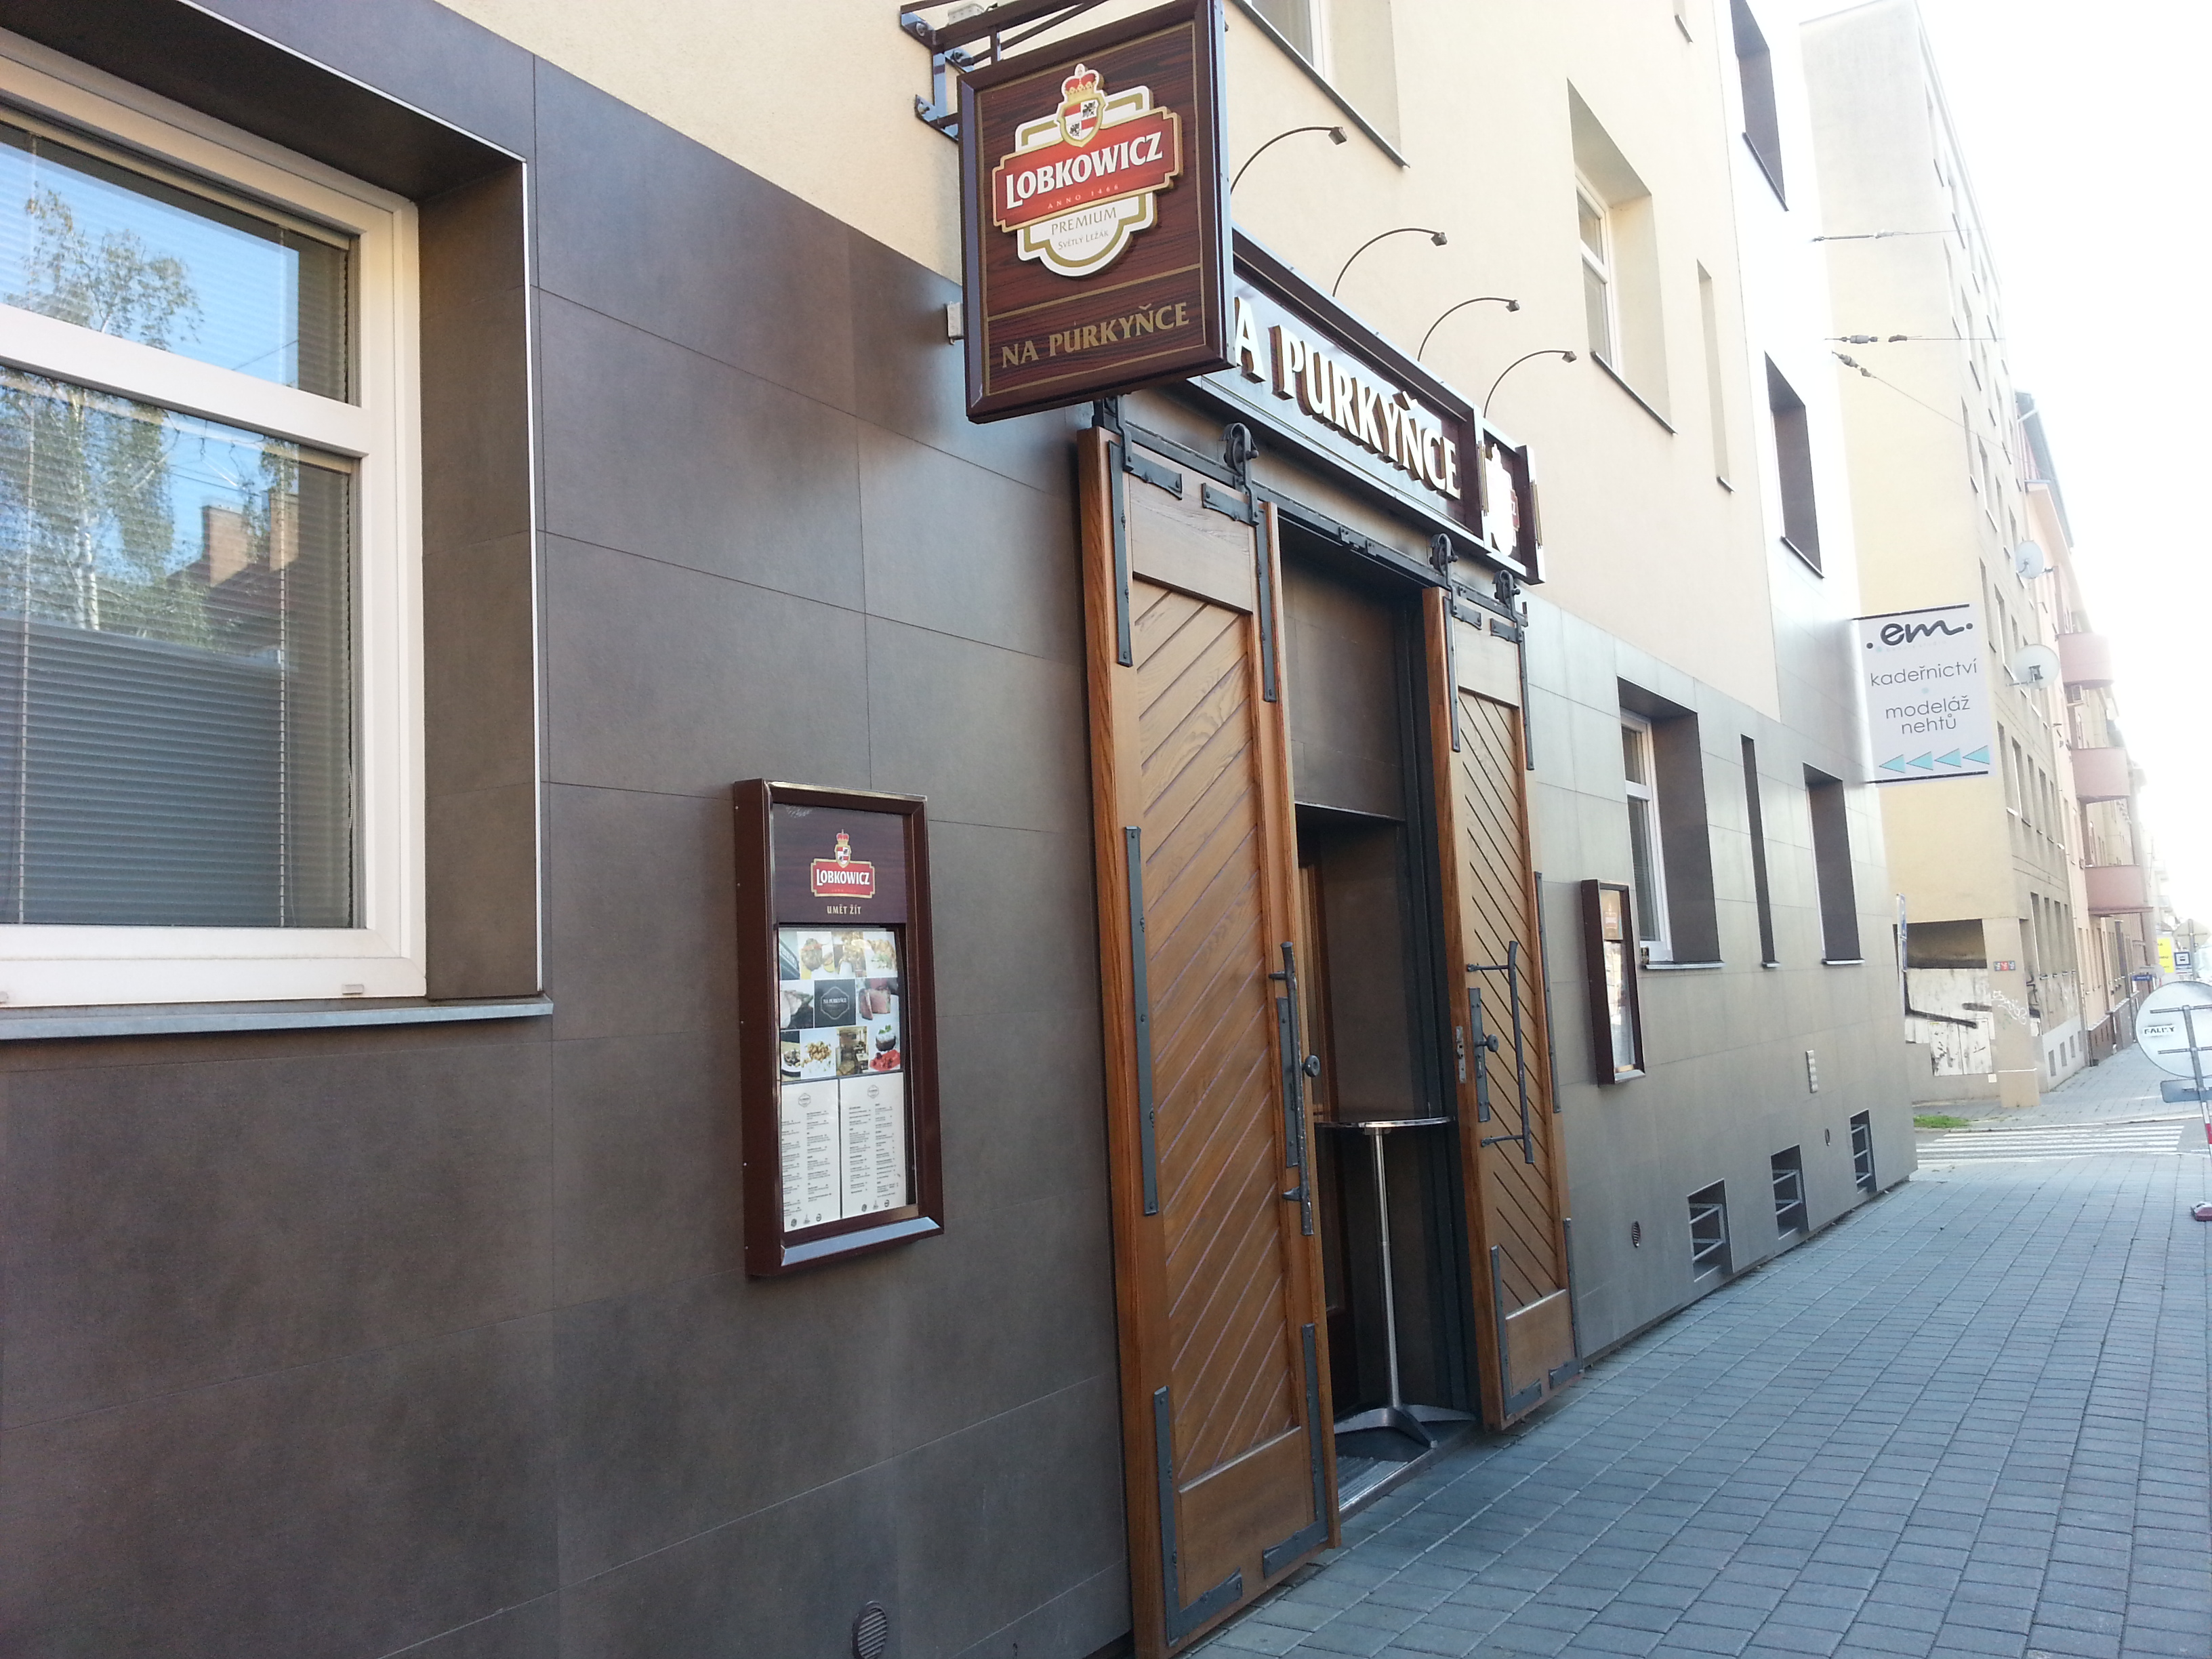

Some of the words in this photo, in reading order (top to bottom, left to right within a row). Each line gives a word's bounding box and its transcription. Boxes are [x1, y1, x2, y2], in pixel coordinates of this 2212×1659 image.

[1006, 131, 1163, 209] LOBKOWICZ
[1048, 194, 1082, 209] ANNO
[1090, 184, 1119, 197] 1466
[1051, 207, 1117, 235] PREMIUM
[1002, 340, 1039, 368] NA
[1049, 302, 1189, 356] PURKYŇCE
[1268, 325, 1461, 501] PURKYŇCE
[1870, 658, 1977, 687] kadeřnictví
[1885, 695, 1971, 718] modeláž
[1902, 713, 1957, 734] nehtů
[816, 869, 870, 886] LOBKOWICZ
[827, 903, 848, 914] UMĚT
[849, 903, 861, 914] ŽÍT
